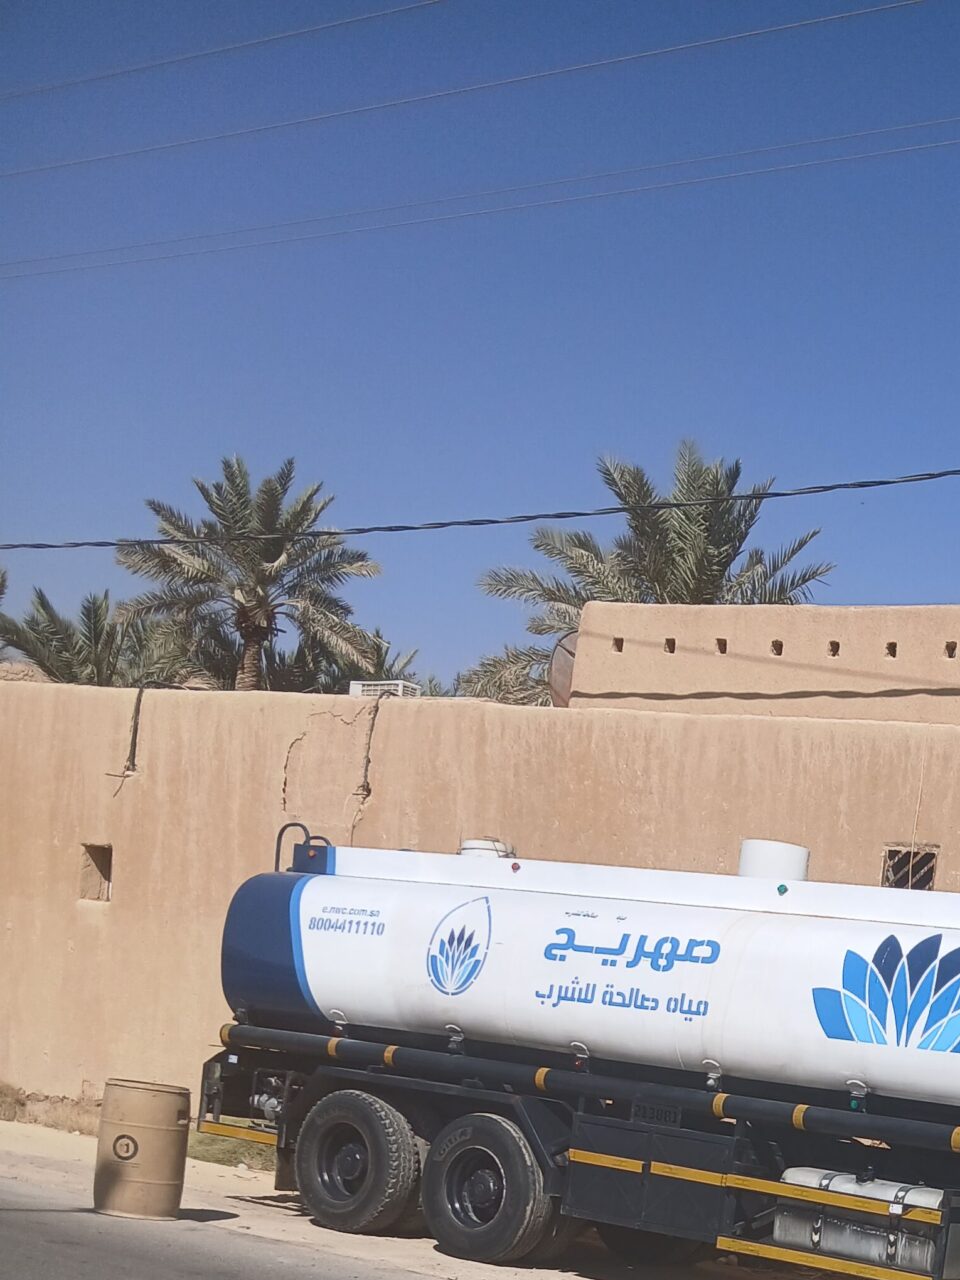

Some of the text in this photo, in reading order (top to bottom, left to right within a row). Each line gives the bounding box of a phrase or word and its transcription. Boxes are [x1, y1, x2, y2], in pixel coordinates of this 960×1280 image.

[308, 916, 386, 936] 8004411110
[543, 927, 721, 972] صهريج
[534, 976, 709, 1022] مياه صالحة للشرب
